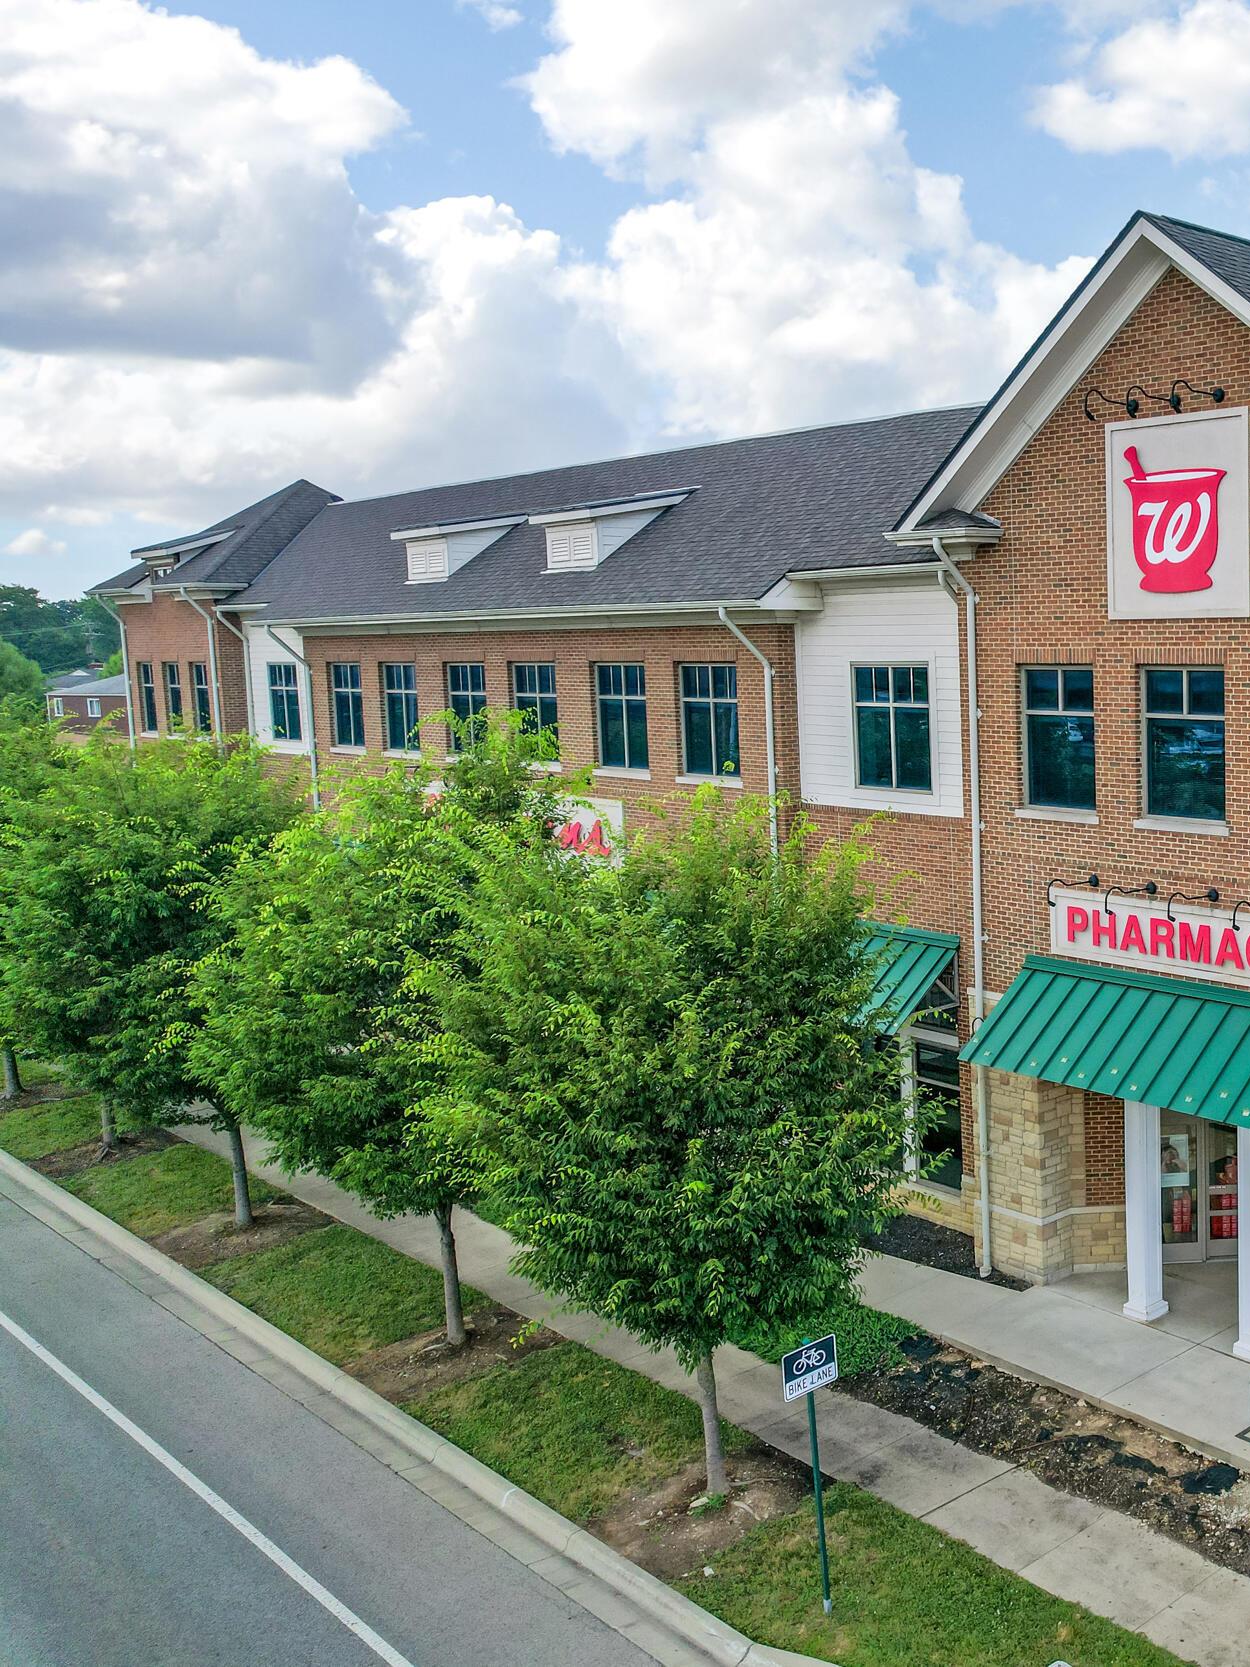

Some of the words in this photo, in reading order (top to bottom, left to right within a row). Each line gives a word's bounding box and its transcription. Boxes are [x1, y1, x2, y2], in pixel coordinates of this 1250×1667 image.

[1137, 492, 1211, 565] W
[788, 1377, 808, 1396] BIKE
[809, 1365, 833, 1385] LANE
